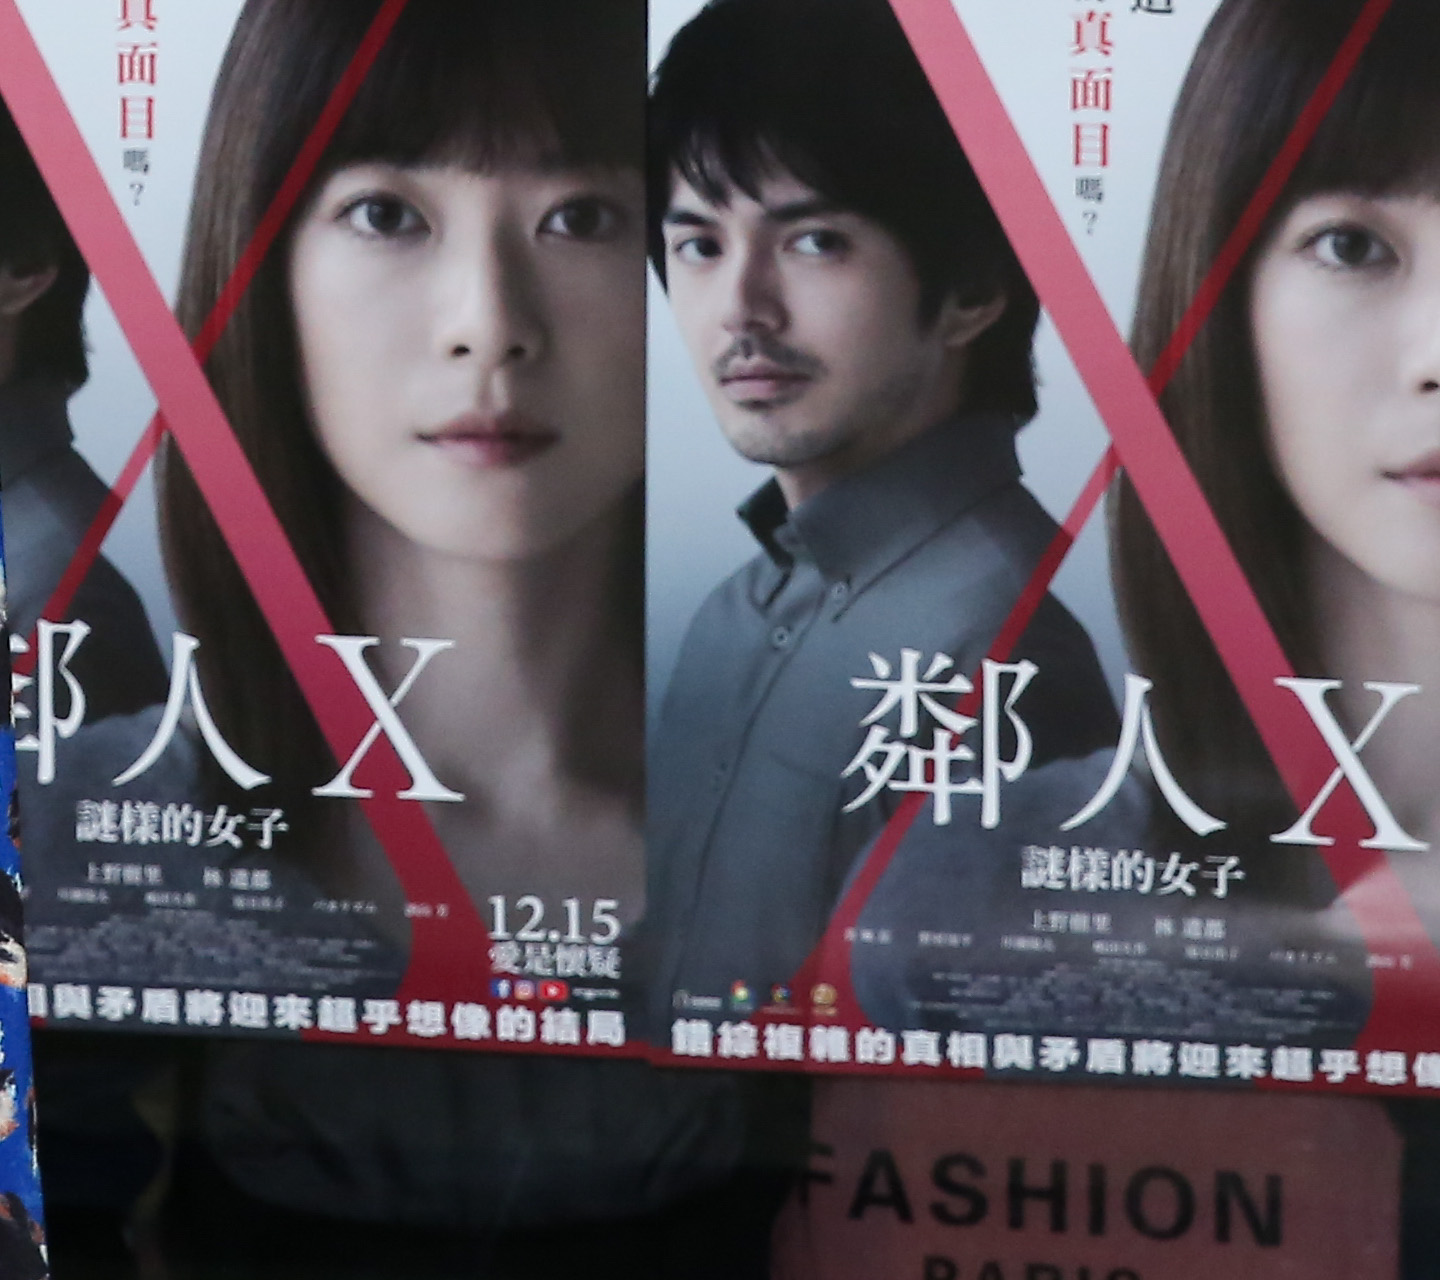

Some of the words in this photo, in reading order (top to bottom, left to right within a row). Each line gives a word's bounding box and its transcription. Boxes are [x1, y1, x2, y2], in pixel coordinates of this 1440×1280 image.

[75, 799, 289, 849] 謎樣的女子
[1020, 843, 1245, 899] 謎樣的女子
[487, 893, 622, 945] 12.15
[796, 1142, 1286, 1250] FASHION
